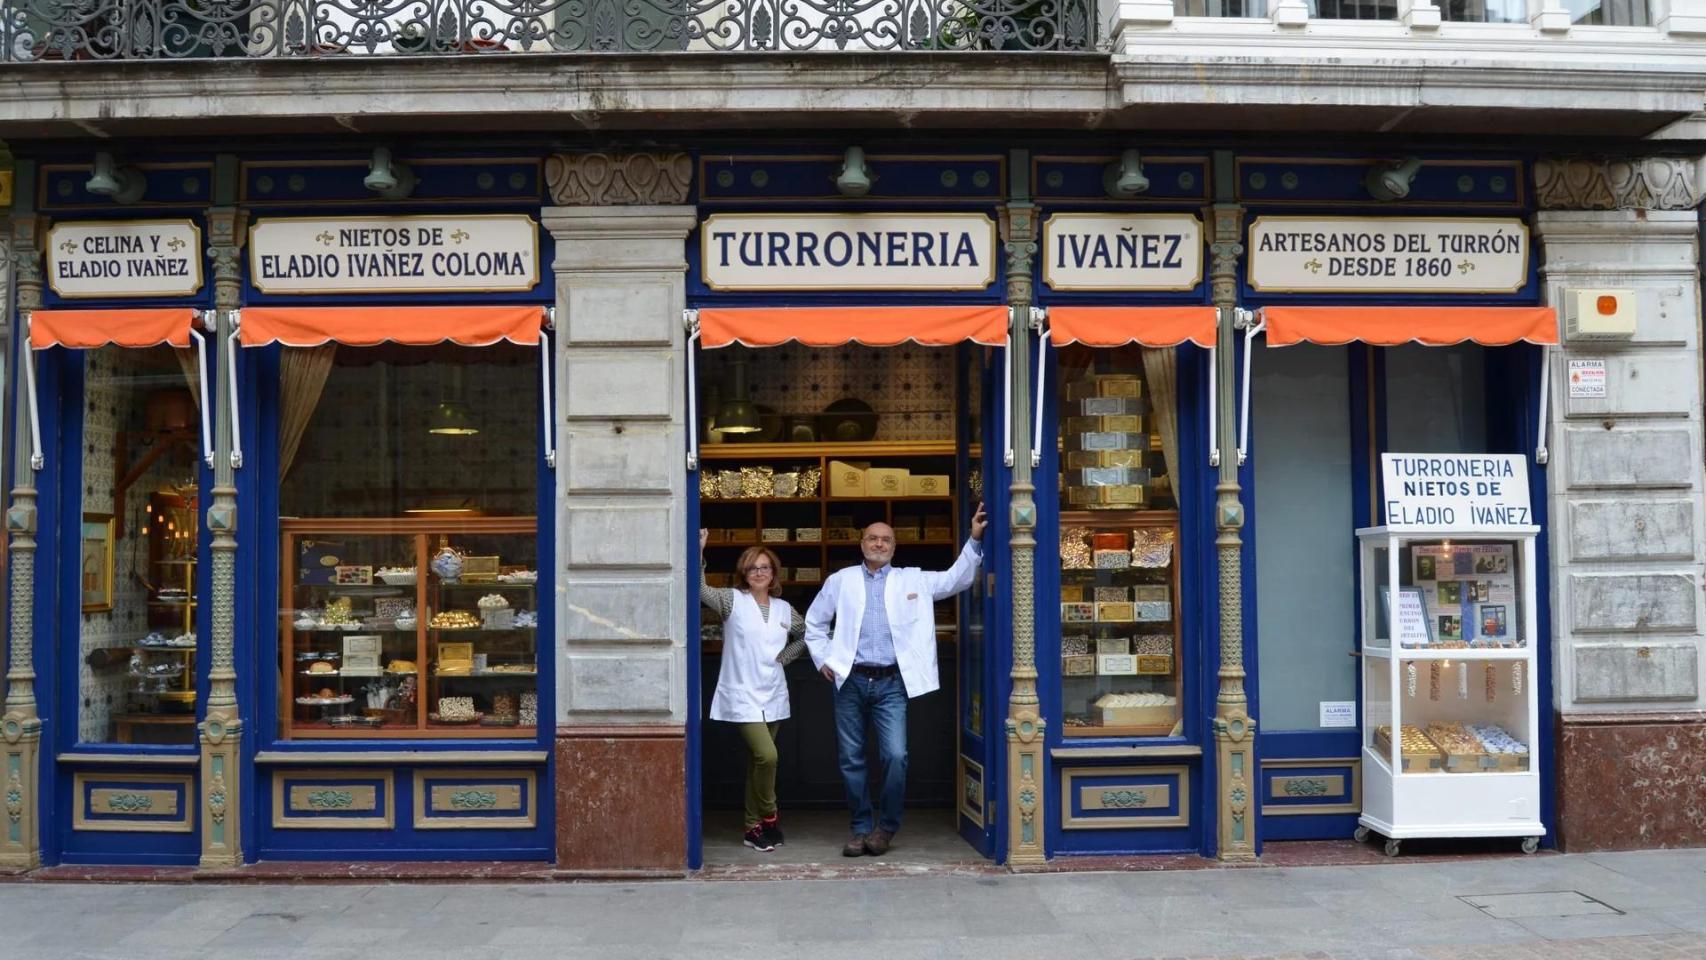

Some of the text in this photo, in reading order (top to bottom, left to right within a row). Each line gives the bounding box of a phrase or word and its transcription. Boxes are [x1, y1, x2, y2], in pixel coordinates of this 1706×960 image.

[83, 235, 161, 254] CELINA Y
[339, 228, 443, 247] NIETOS DE
[712, 230, 979, 267] TURRONERIA
[1056, 227, 1183, 268] IVAÑEZ
[1258, 229, 1520, 254] ARTESANOS DEL TURRÓN
[58, 255, 189, 278] ELADIO IVAÑEZ
[260, 249, 526, 279] ELADIO IVAÑEZ COLOMA
[1327, 257, 1452, 277] DESDE 1860
[1391, 458, 1514, 477] TURRONERIA
[1404, 480, 1502, 496] NIETOS DE
[1387, 500, 1455, 525] ELADIO
